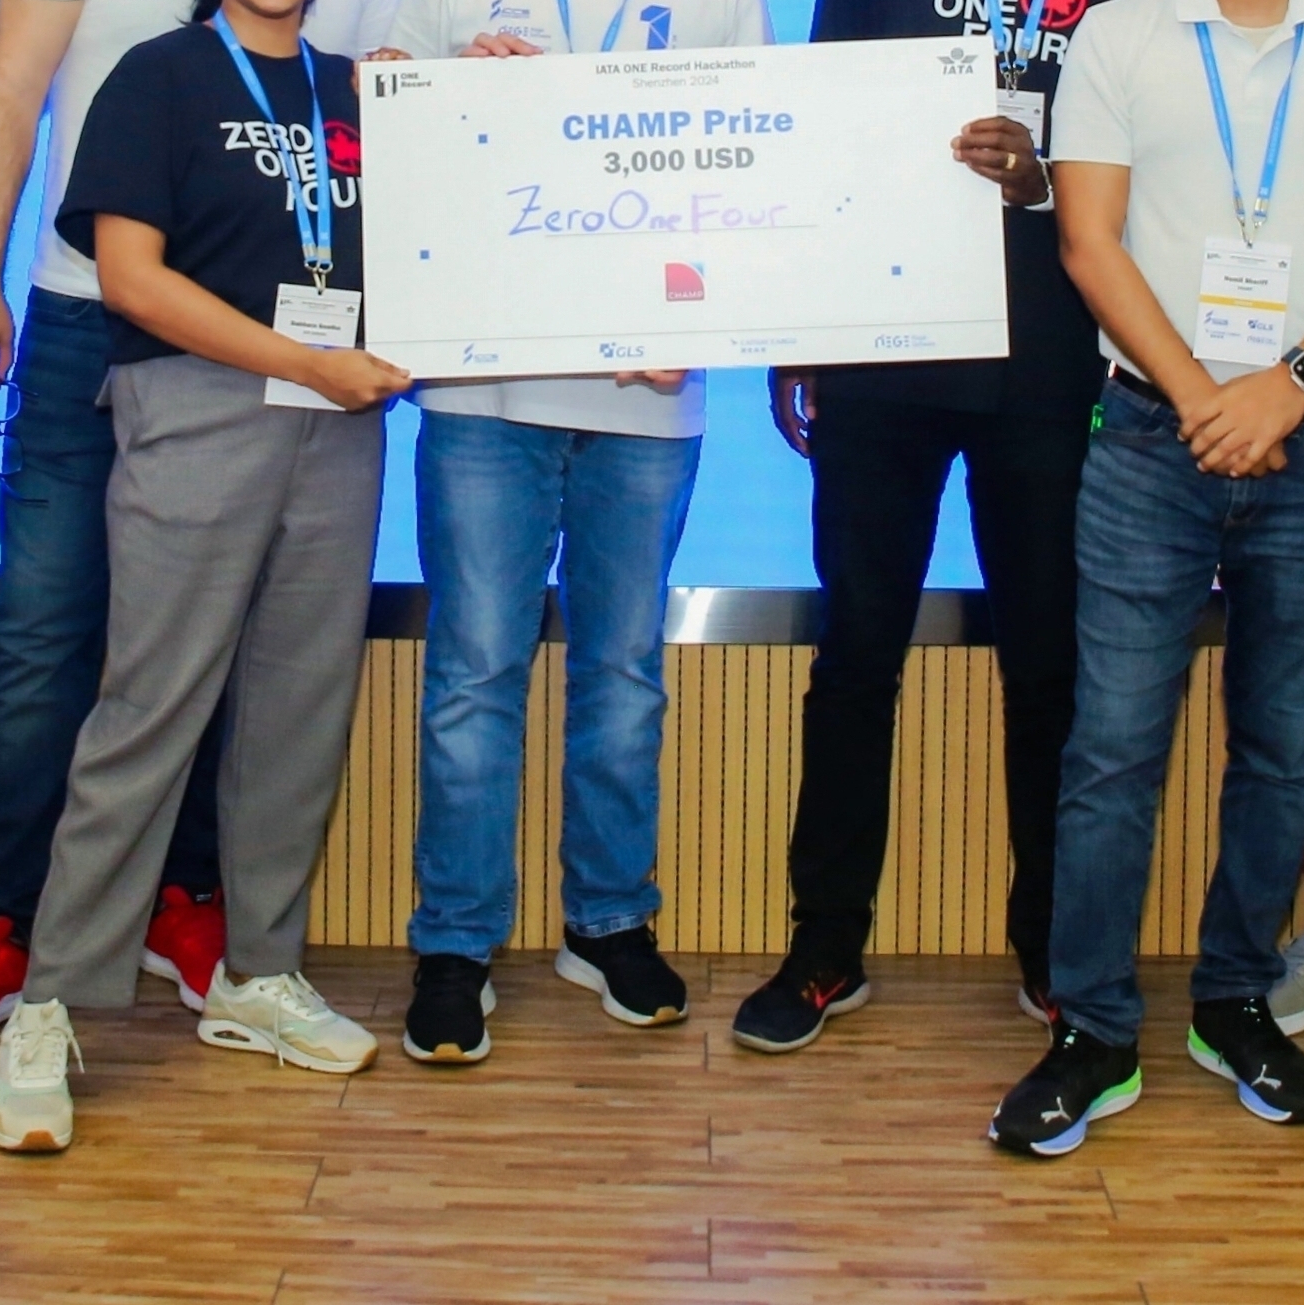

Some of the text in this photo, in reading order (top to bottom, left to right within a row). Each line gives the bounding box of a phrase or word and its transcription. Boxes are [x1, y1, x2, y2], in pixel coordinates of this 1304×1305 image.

[596, 59, 756, 75] IATA ONE Record Hackathon
[942, 65, 974, 75] IATA
[632, 75, 720, 89] Shenzhen 2024
[562, 107, 793, 141] CHAMP Prize
[219, 120, 313, 153] ZERO
[255, 149, 317, 183] ONE
[604, 146, 754, 178] 3,000 USD
[286, 176, 362, 212] OU
[668, 290, 704, 300] CHAMP
[616, 345, 644, 358] GLS
